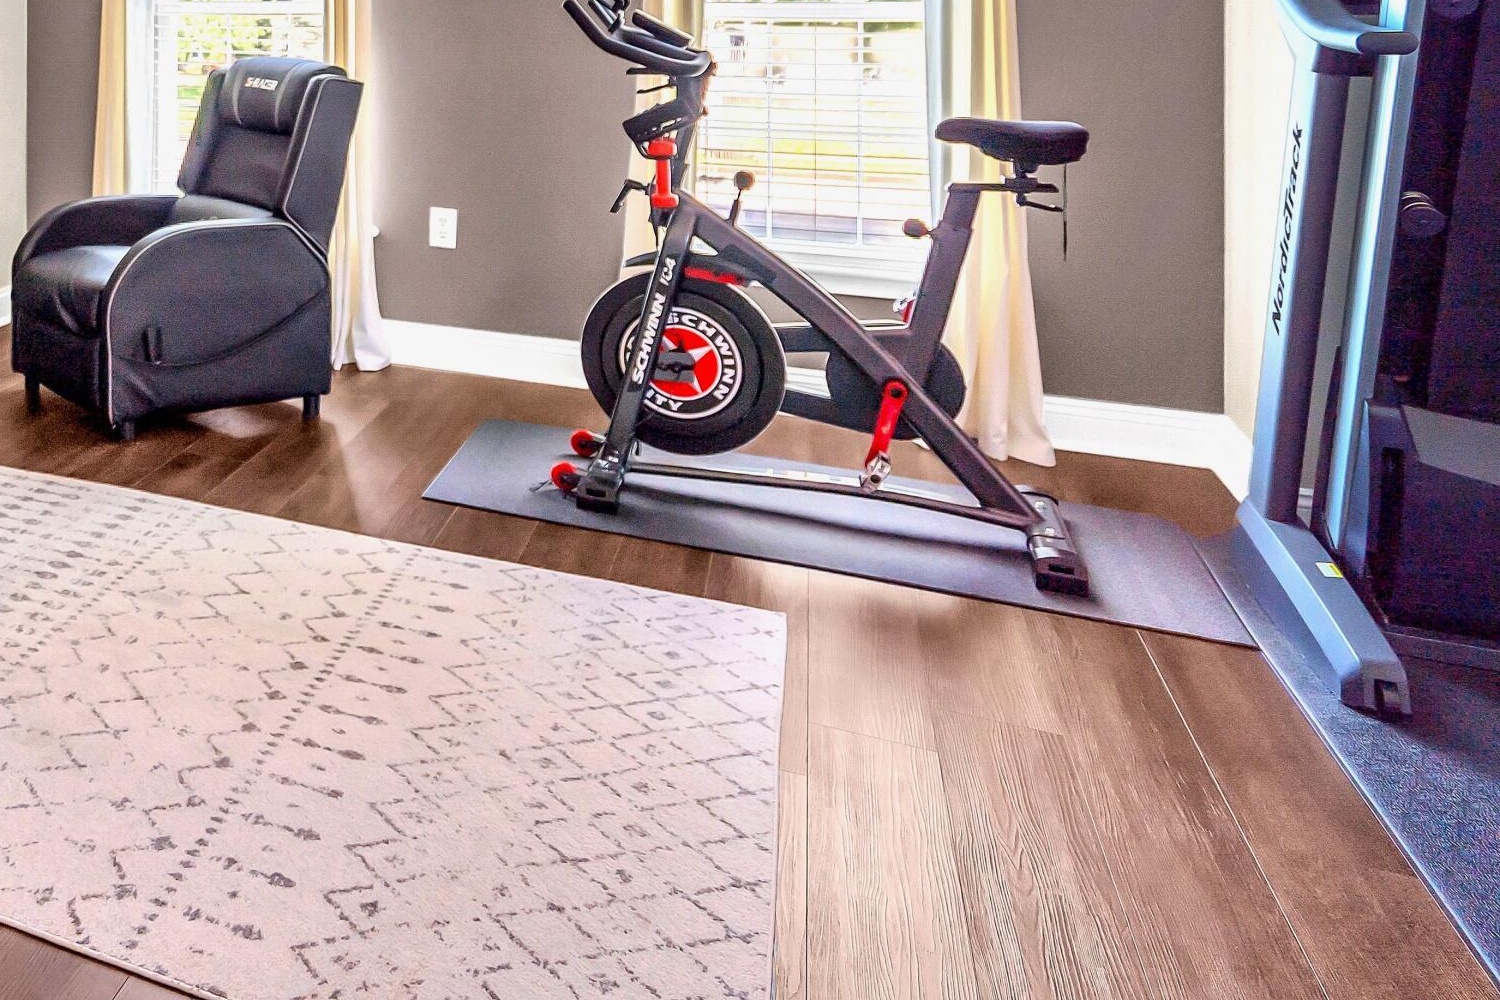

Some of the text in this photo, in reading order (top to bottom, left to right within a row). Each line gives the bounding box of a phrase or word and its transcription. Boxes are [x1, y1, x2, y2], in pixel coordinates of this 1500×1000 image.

[1271, 122, 1303, 336] NordicTrack
[631, 292, 667, 384] SCHWINN
[666, 312, 736, 400] SCHWINN
